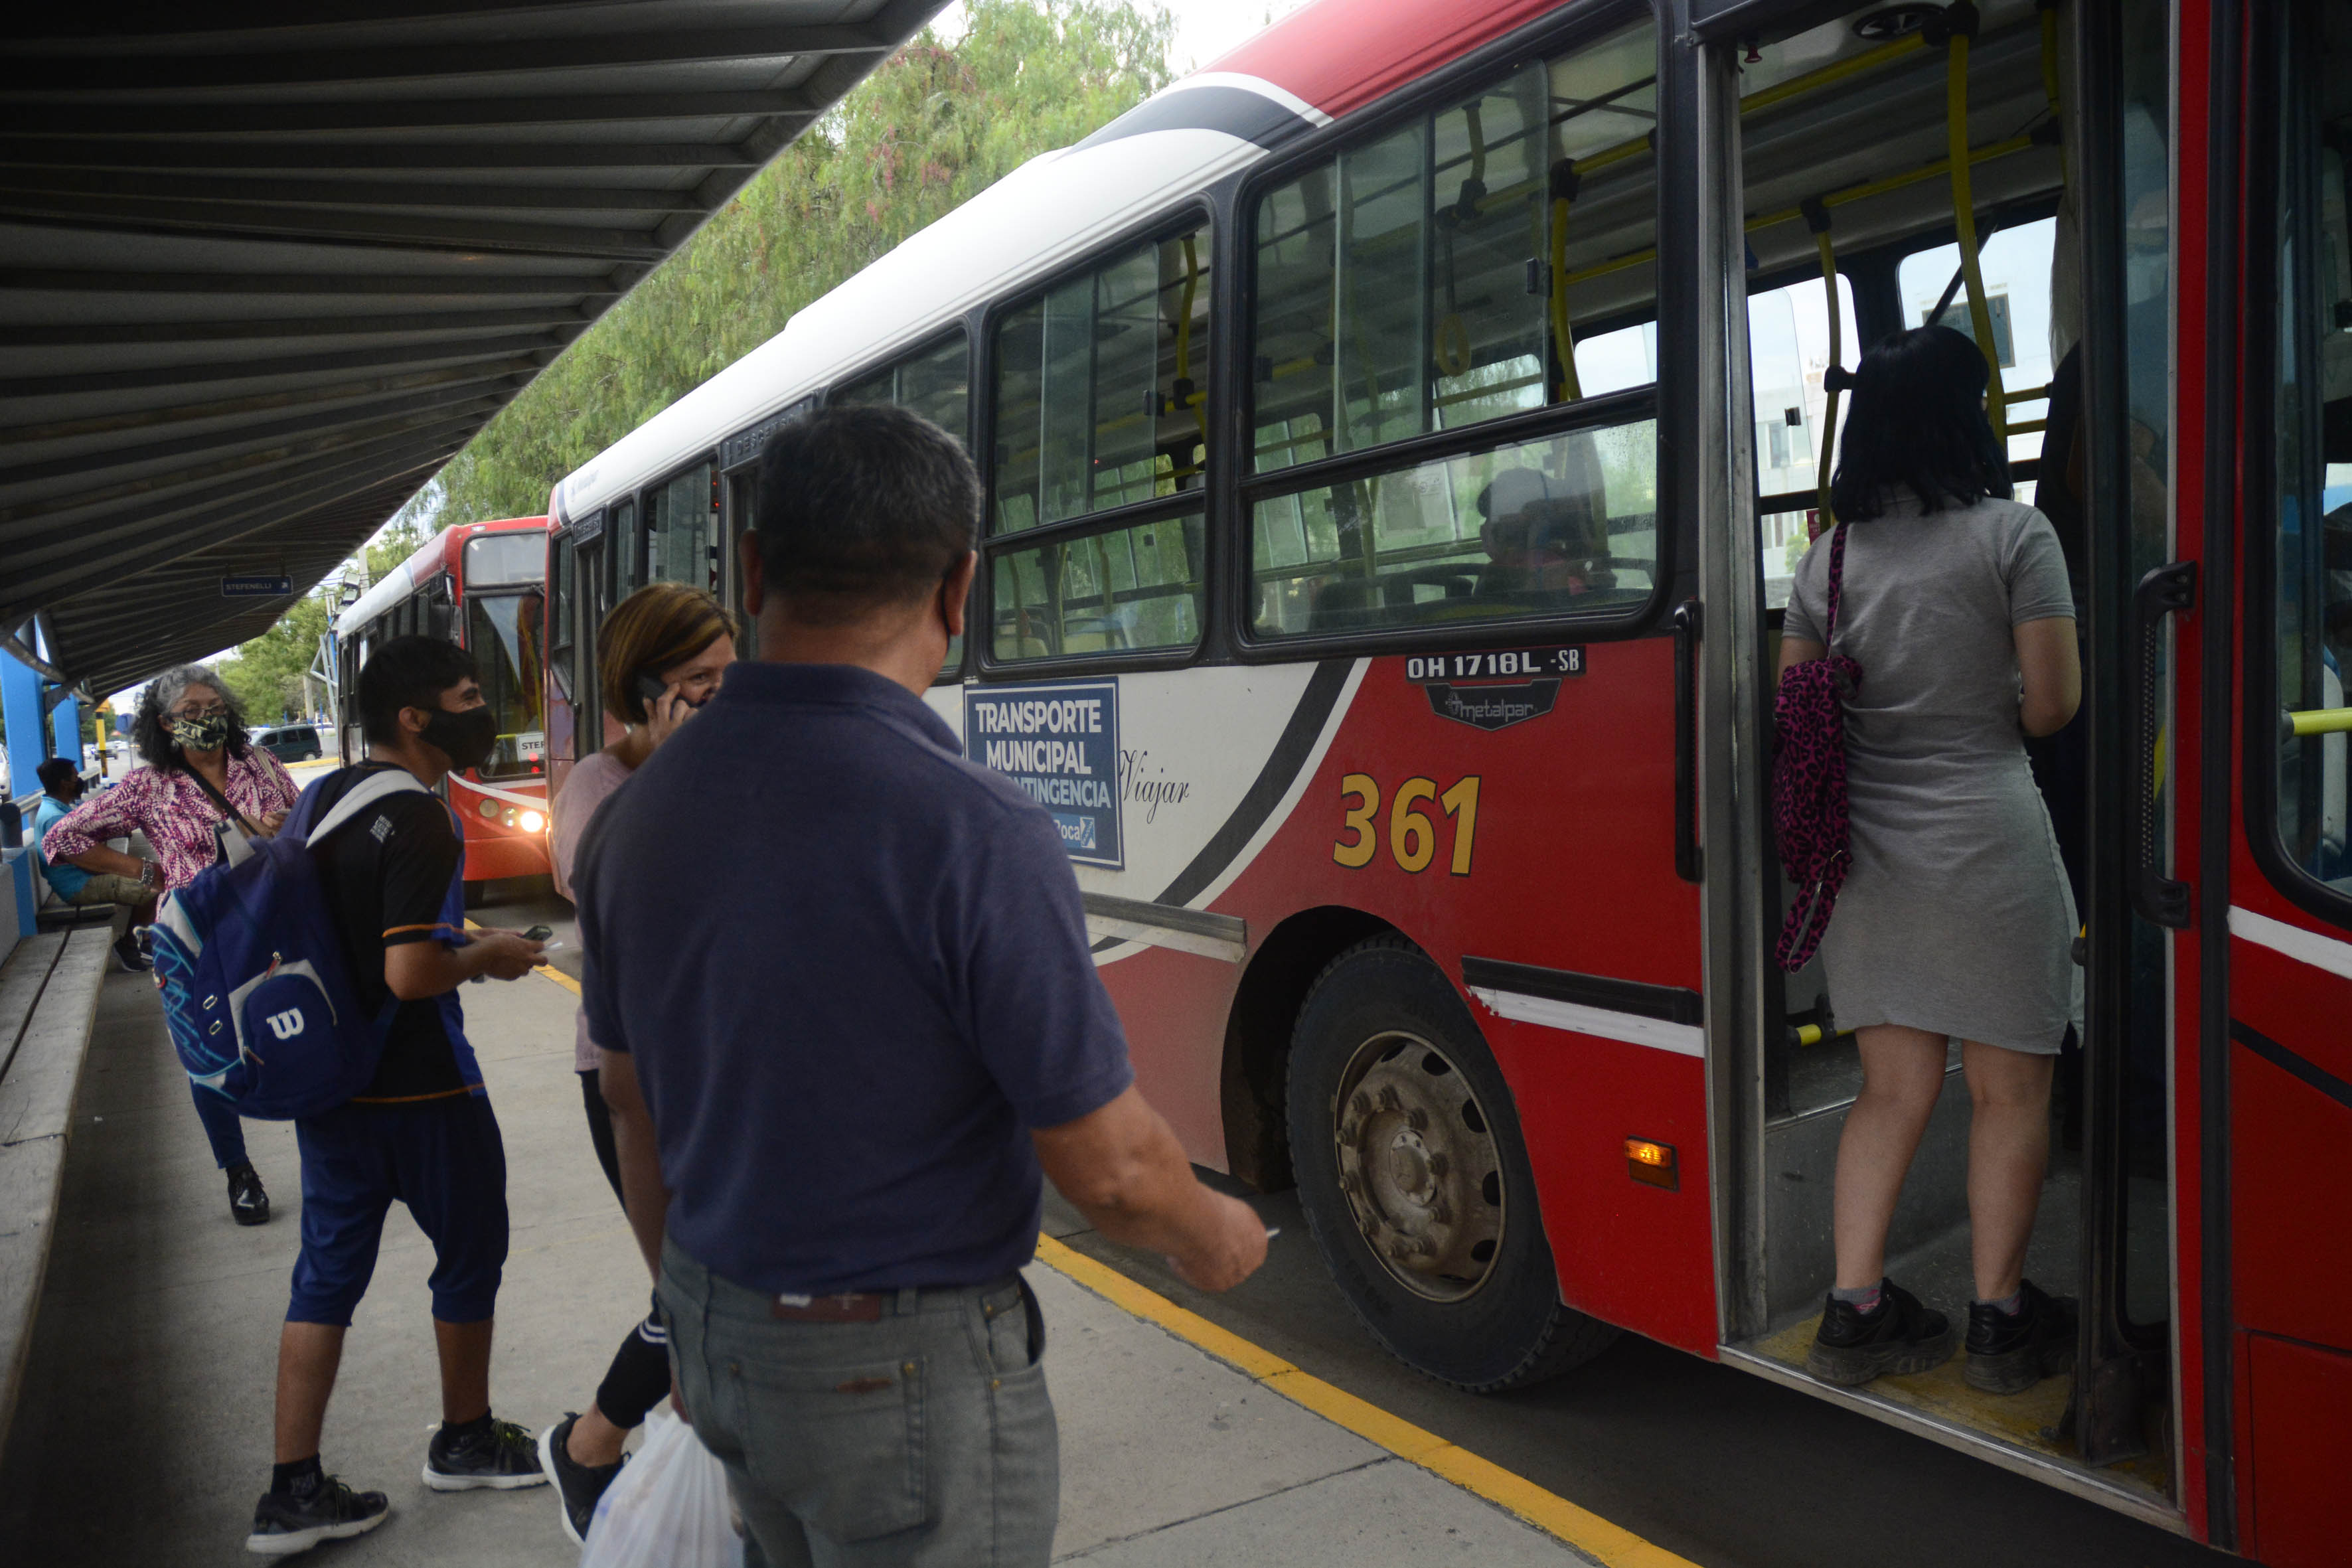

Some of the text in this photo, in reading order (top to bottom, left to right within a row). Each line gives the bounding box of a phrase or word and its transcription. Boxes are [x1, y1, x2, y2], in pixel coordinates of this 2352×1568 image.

[1408, 657, 1445, 678] OH
[1454, 652, 1541, 676] 1718L
[975, 699, 1101, 734] TRANSPORTE
[1460, 698, 1534, 722] metalpar
[986, 740, 1091, 775] MUNICIPAL
[1119, 749, 1190, 824] Viajar
[1332, 771, 1482, 877] 361
